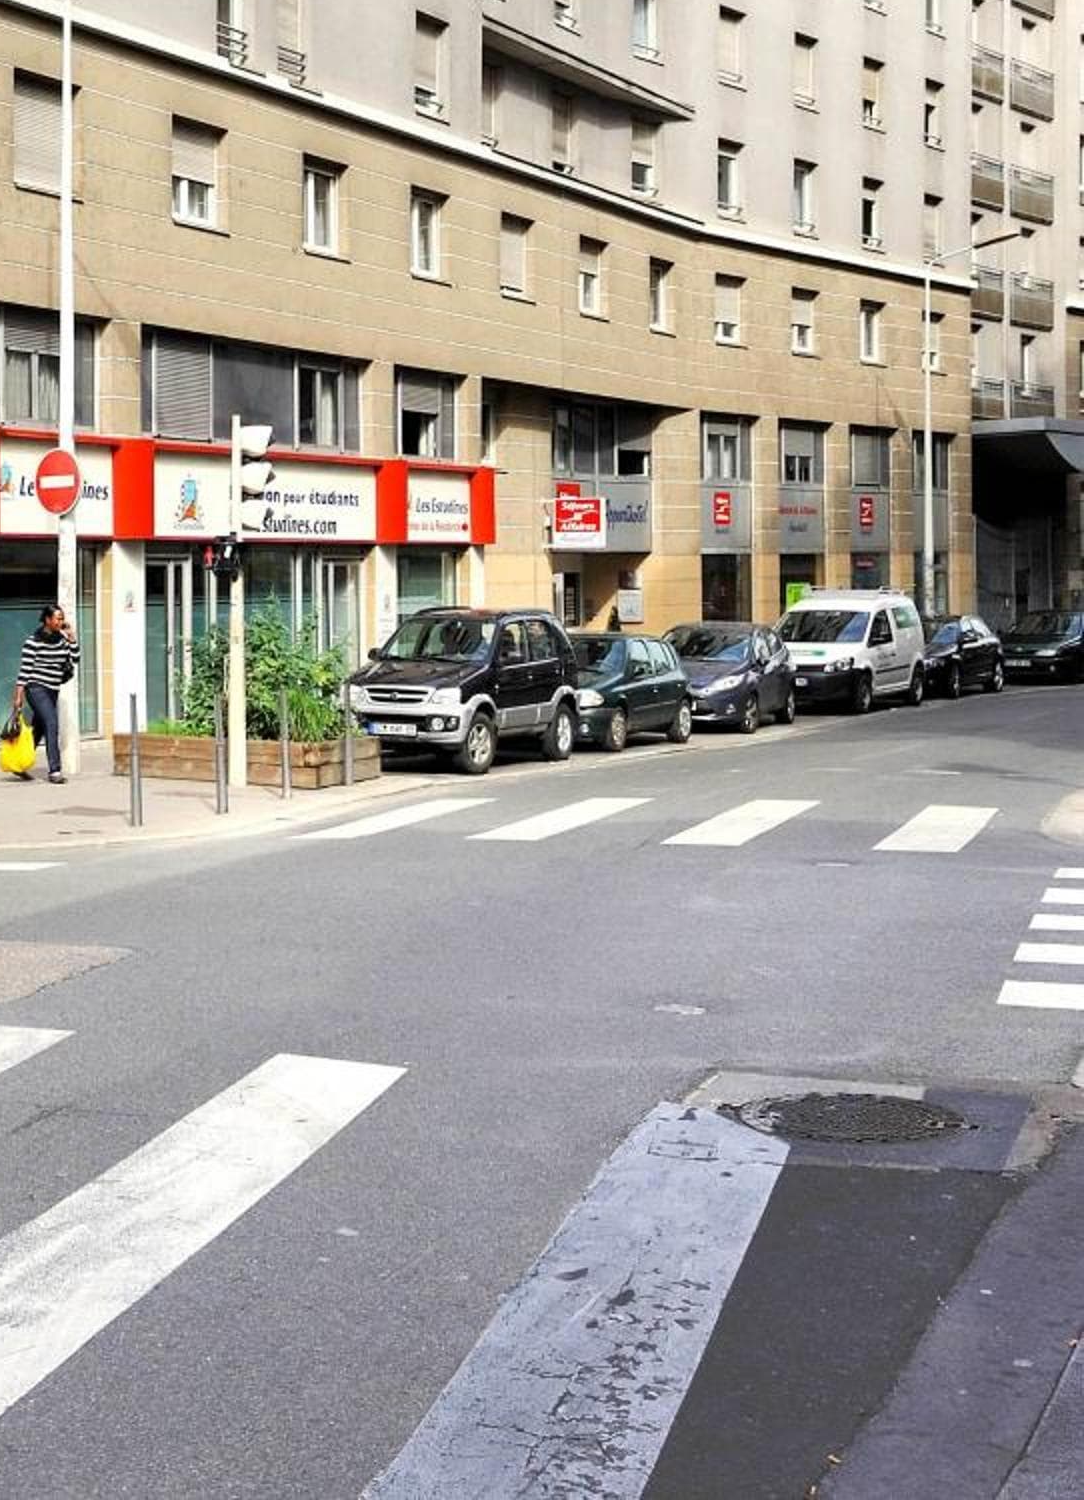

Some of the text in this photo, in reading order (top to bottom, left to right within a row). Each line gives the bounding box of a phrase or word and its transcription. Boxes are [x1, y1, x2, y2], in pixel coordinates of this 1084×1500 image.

[19, 475, 35, 497] Le
[283, 493, 305, 506] pour
[309, 488, 360, 507] étudiants
[415, 497, 469, 515] Les Estudines
[262, 514, 337, 535] studines.com
